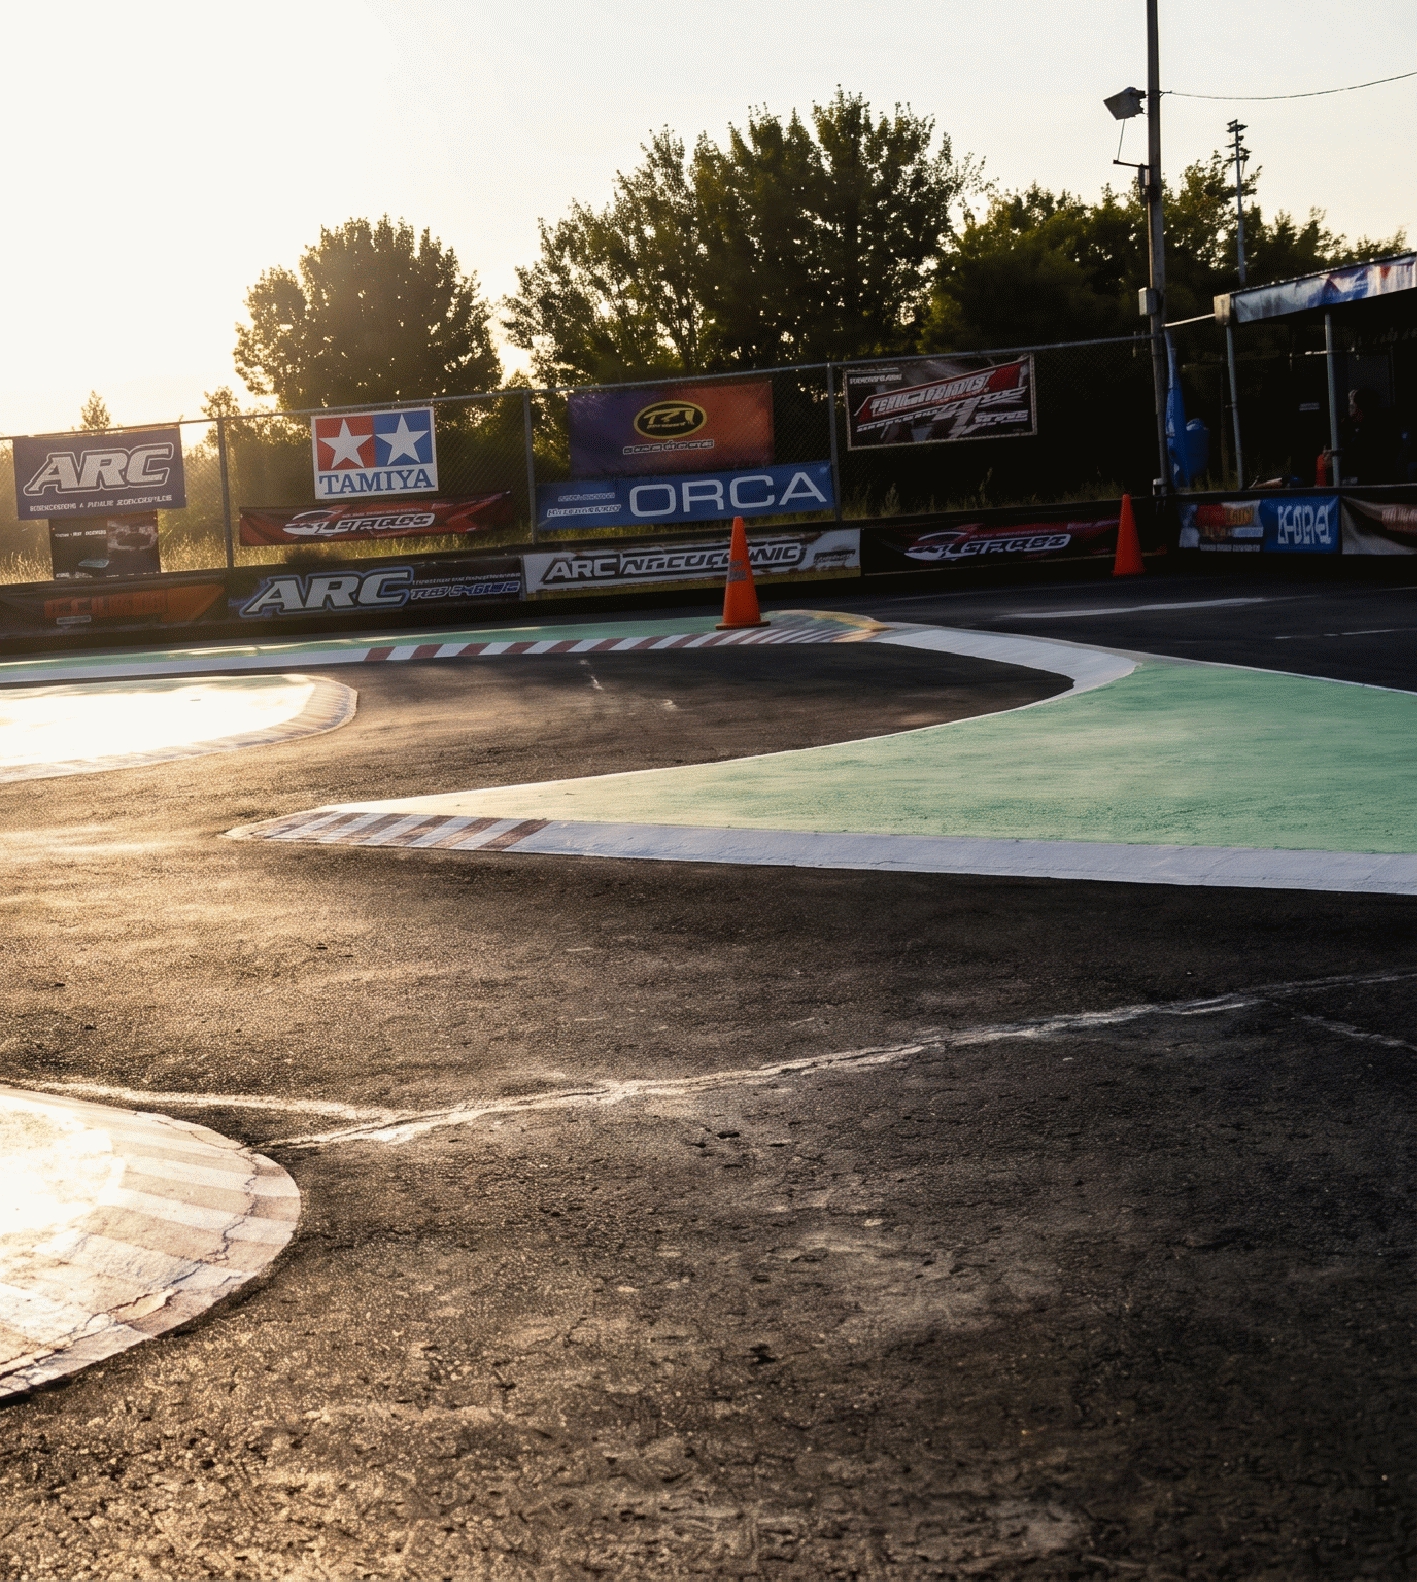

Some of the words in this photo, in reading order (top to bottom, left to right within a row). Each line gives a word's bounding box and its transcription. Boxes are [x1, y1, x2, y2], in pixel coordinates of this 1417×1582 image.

[25, 444, 172, 494] ARC
[319, 468, 435, 496] TAMIYA
[629, 471, 827, 518] ORCA
[242, 568, 412, 615] ARC
[544, 557, 621, 582] ARC
